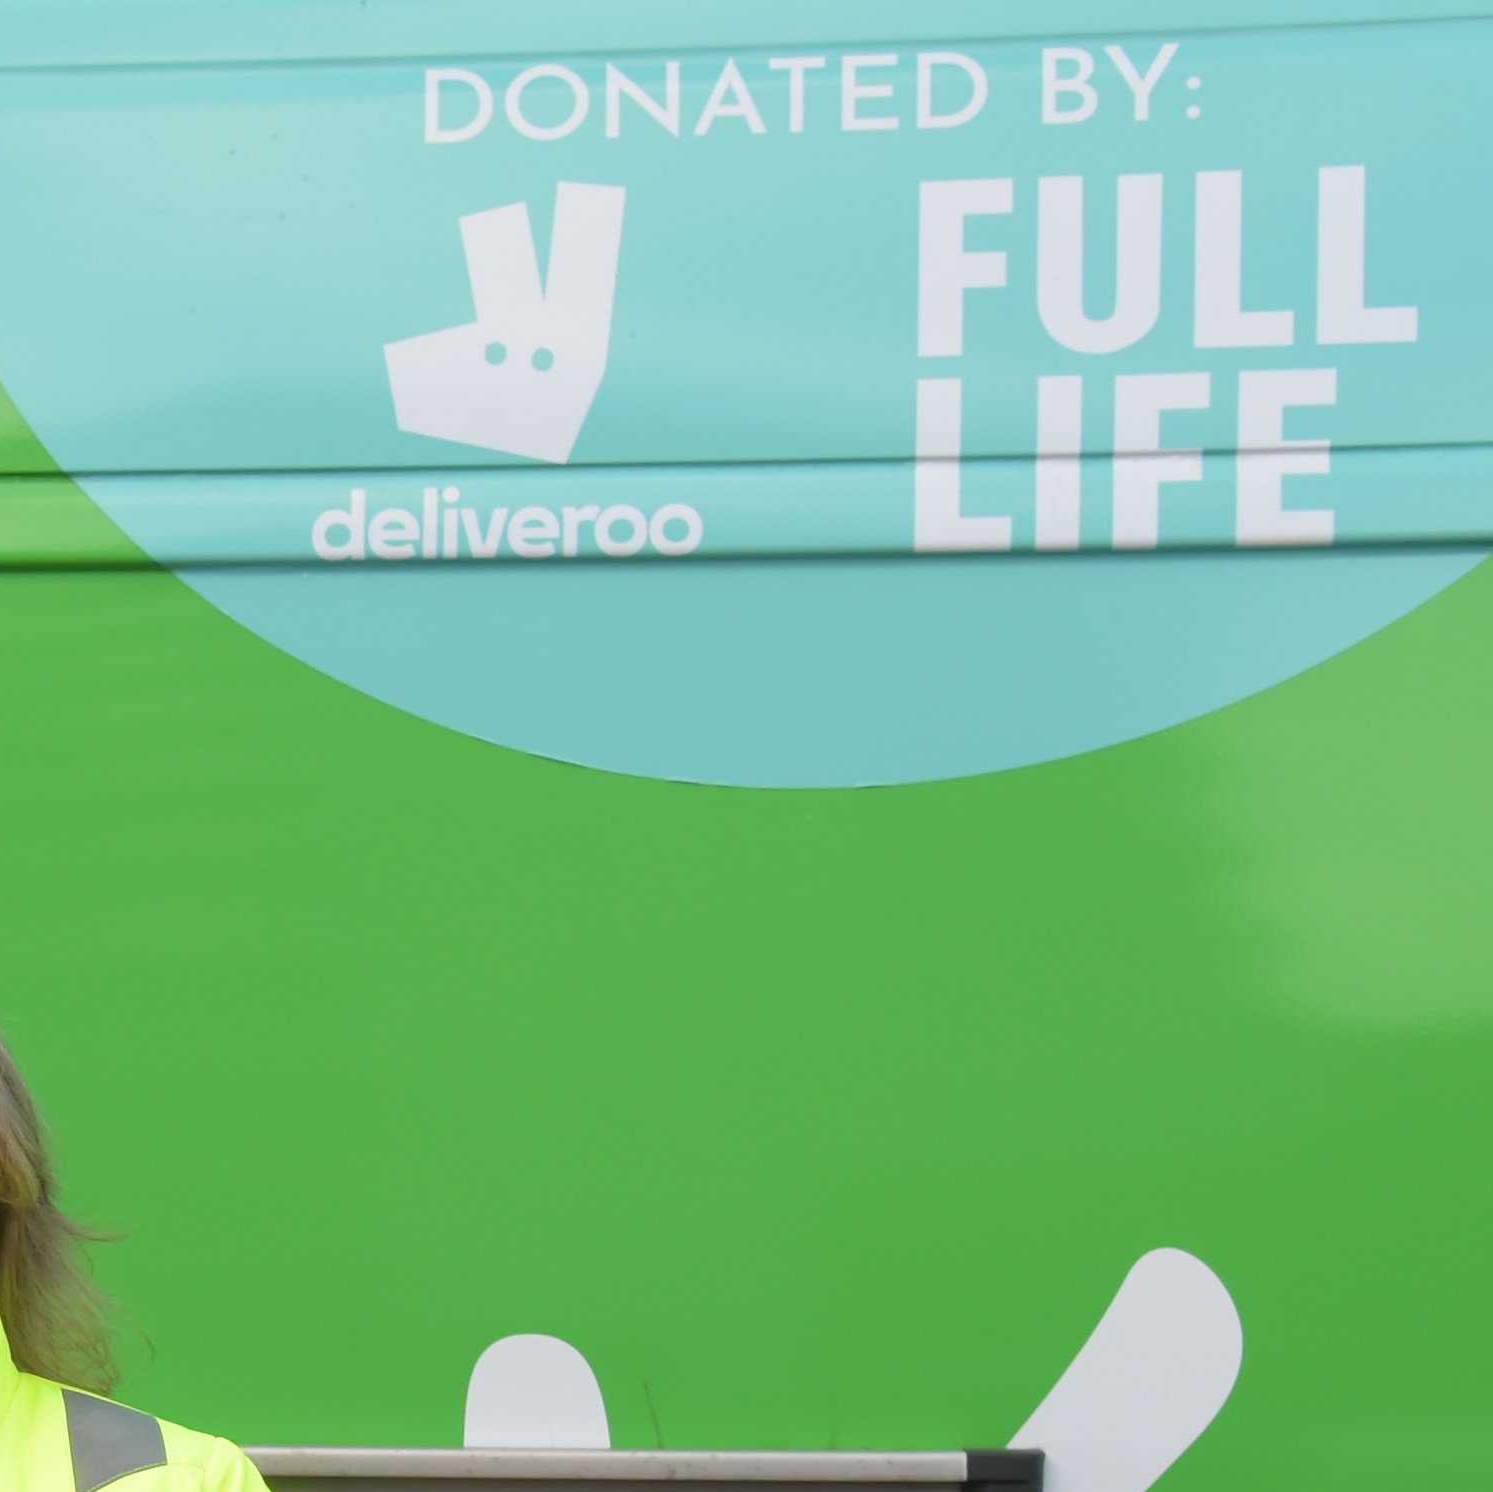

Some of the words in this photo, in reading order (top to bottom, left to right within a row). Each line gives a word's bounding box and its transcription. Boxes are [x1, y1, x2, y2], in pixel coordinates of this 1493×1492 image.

[423, 52, 989, 145] DONATED
[1042, 42, 1203, 126] BY:
[918, 165, 1419, 357] FULL
[311, 487, 704, 561] deliveroo
[914, 368, 1338, 553] LIFE
